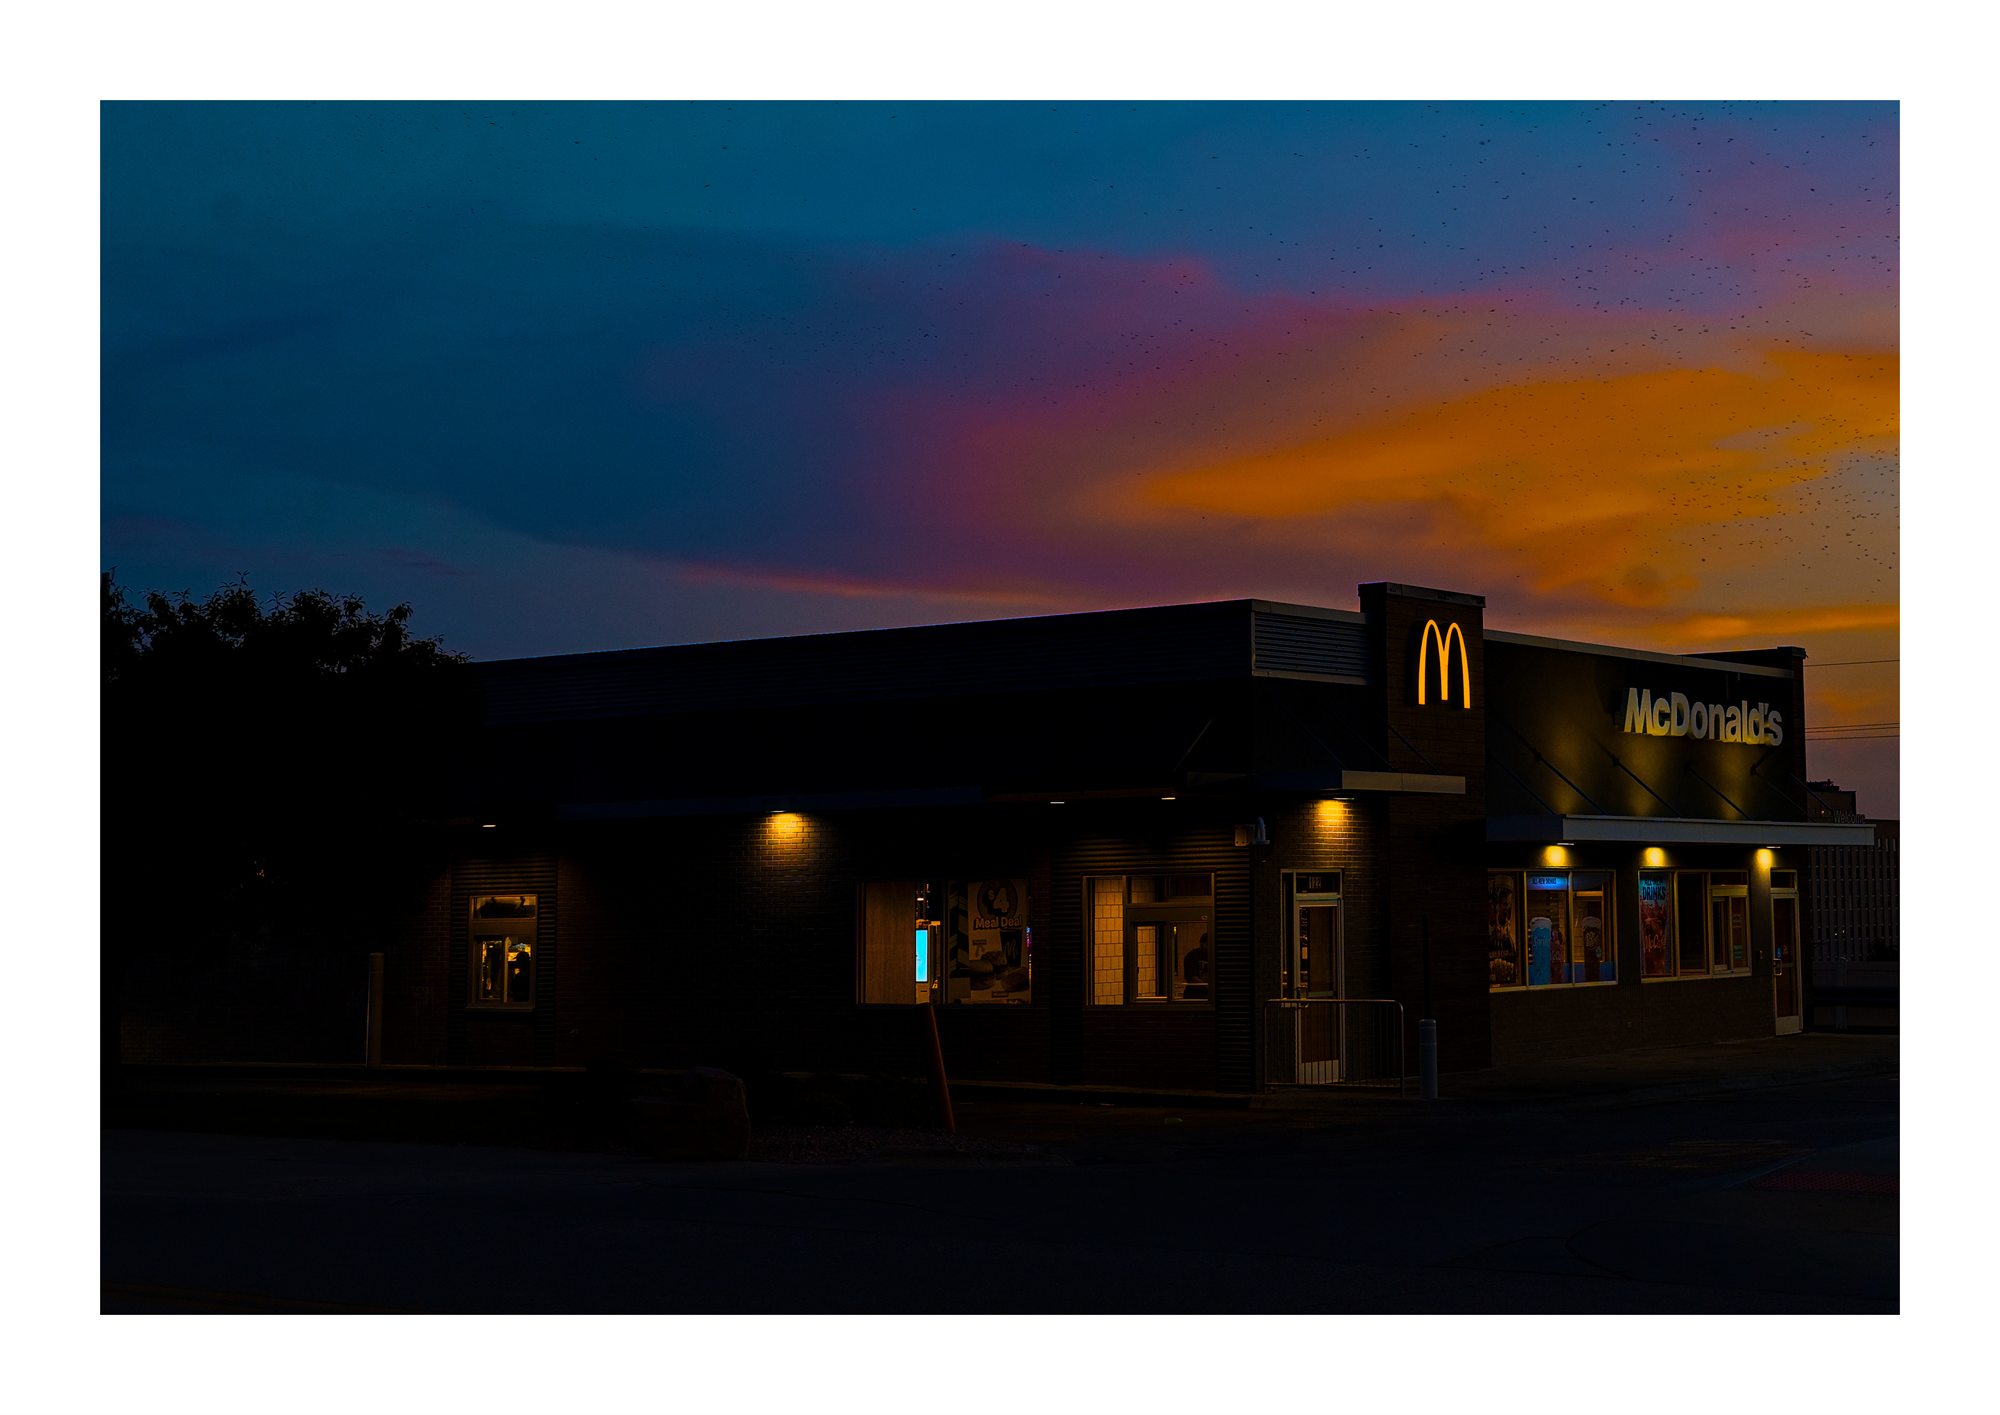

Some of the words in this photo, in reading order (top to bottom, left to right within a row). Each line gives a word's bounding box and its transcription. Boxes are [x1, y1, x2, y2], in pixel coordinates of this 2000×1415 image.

[1624, 687, 1783, 747] McDonald's
[1642, 886, 1666, 901] DRINKS
[975, 917, 999, 930] Meal
[1001, 916, 1022, 928] Deal
